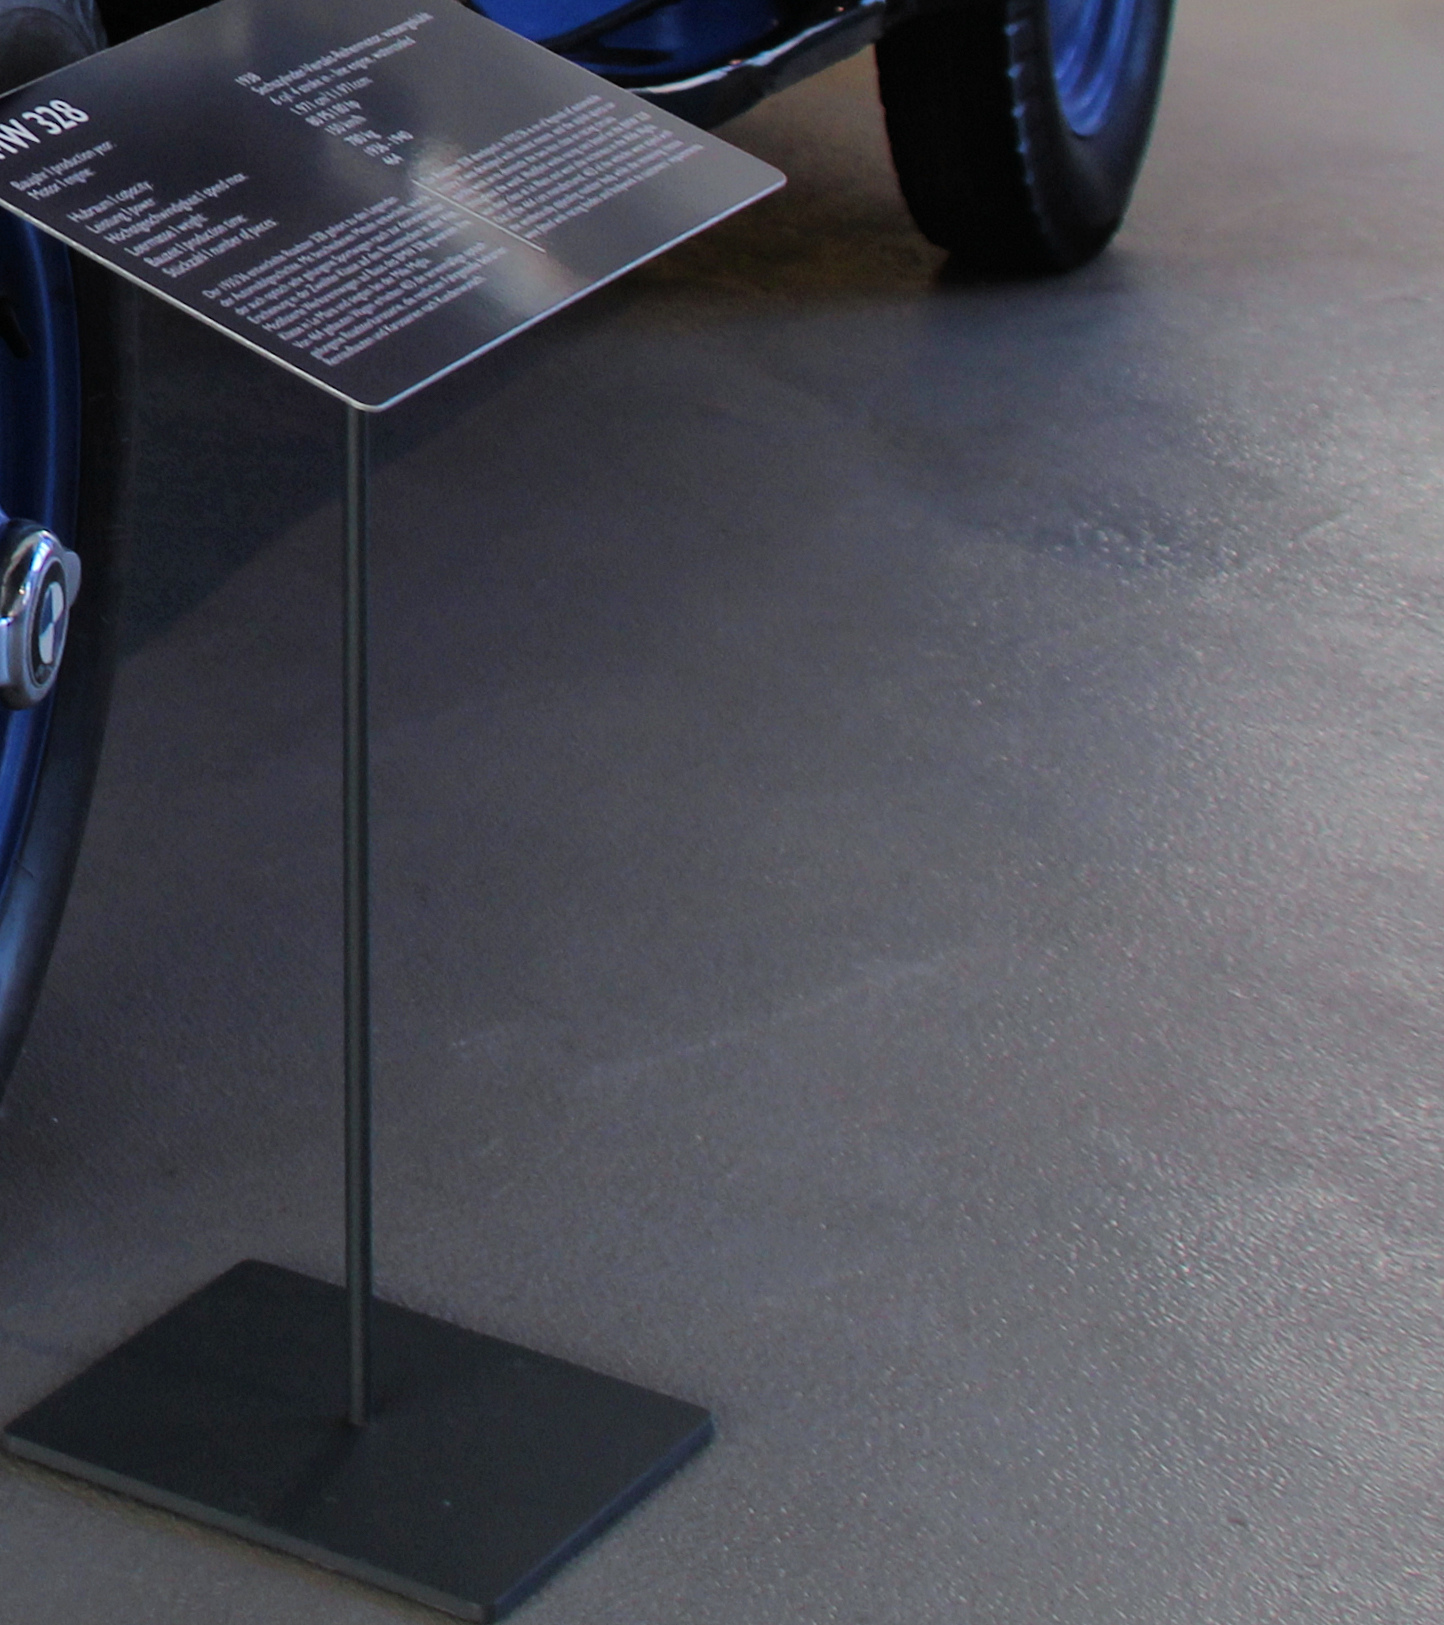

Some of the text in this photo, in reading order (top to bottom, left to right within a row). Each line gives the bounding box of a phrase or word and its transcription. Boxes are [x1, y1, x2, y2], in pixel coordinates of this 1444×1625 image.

[21, 100, 88, 134] 328
[50, 150, 96, 174] production
[27, 183, 60, 200] Motor
[66, 200, 113, 222] Hubraum
[181, 224, 227, 251] production
